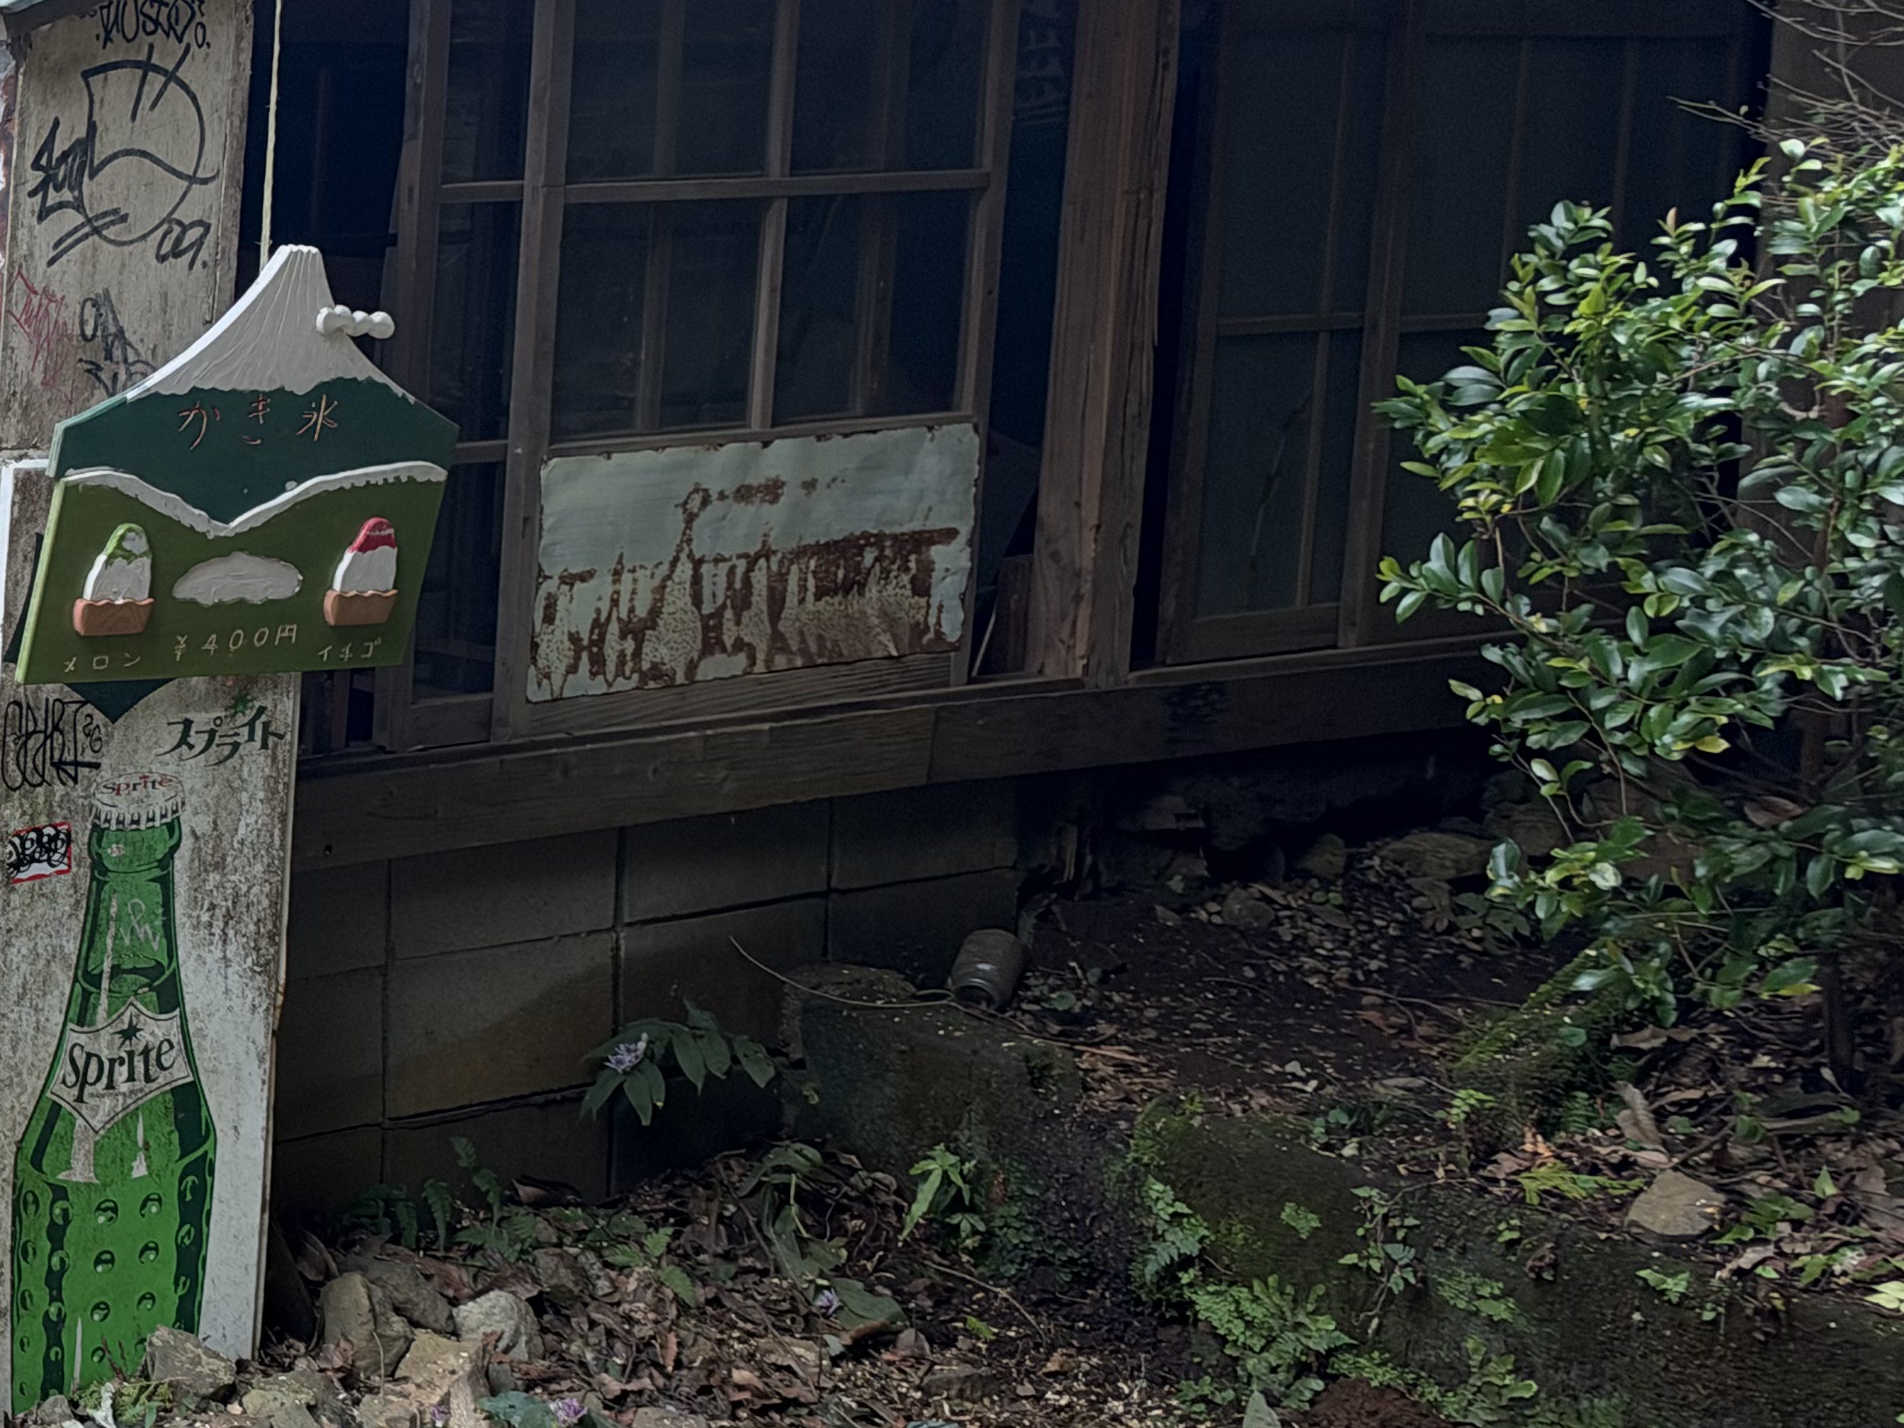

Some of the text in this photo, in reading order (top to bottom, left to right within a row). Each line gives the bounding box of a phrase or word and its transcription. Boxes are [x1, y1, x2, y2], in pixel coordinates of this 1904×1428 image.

[178, 394, 338, 451] かき氷
[64, 652, 141, 673] メロン
[174, 624, 298, 662] ¥400円
[318, 637, 382, 662] イチゴ
[156, 705, 285, 767] スプライト
[61, 1038, 175, 1104] Sprite
